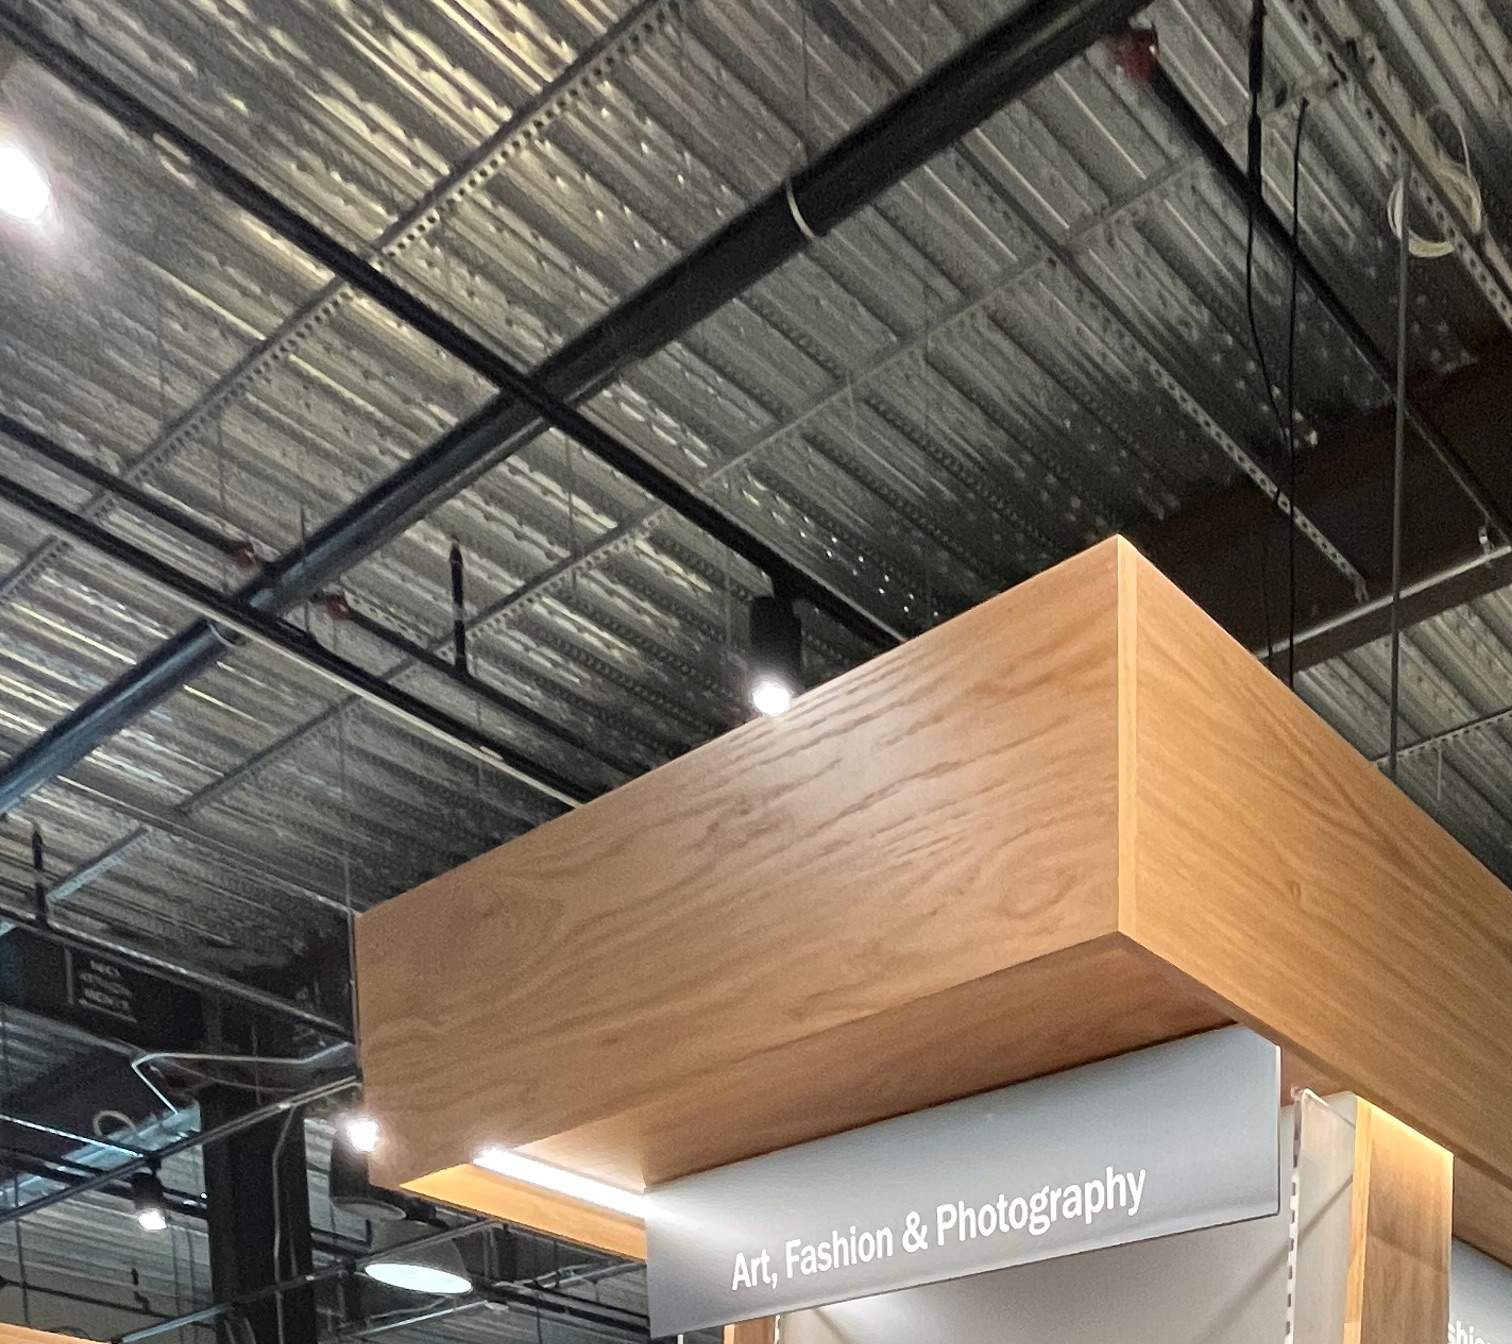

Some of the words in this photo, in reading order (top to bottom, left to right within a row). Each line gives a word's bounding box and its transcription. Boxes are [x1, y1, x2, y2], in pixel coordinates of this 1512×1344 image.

[731, 1251, 779, 1292] Art,
[785, 1227, 893, 1277] Fashion
[901, 1216, 928, 1253] &
[936, 1165, 1147, 1244] Photography
